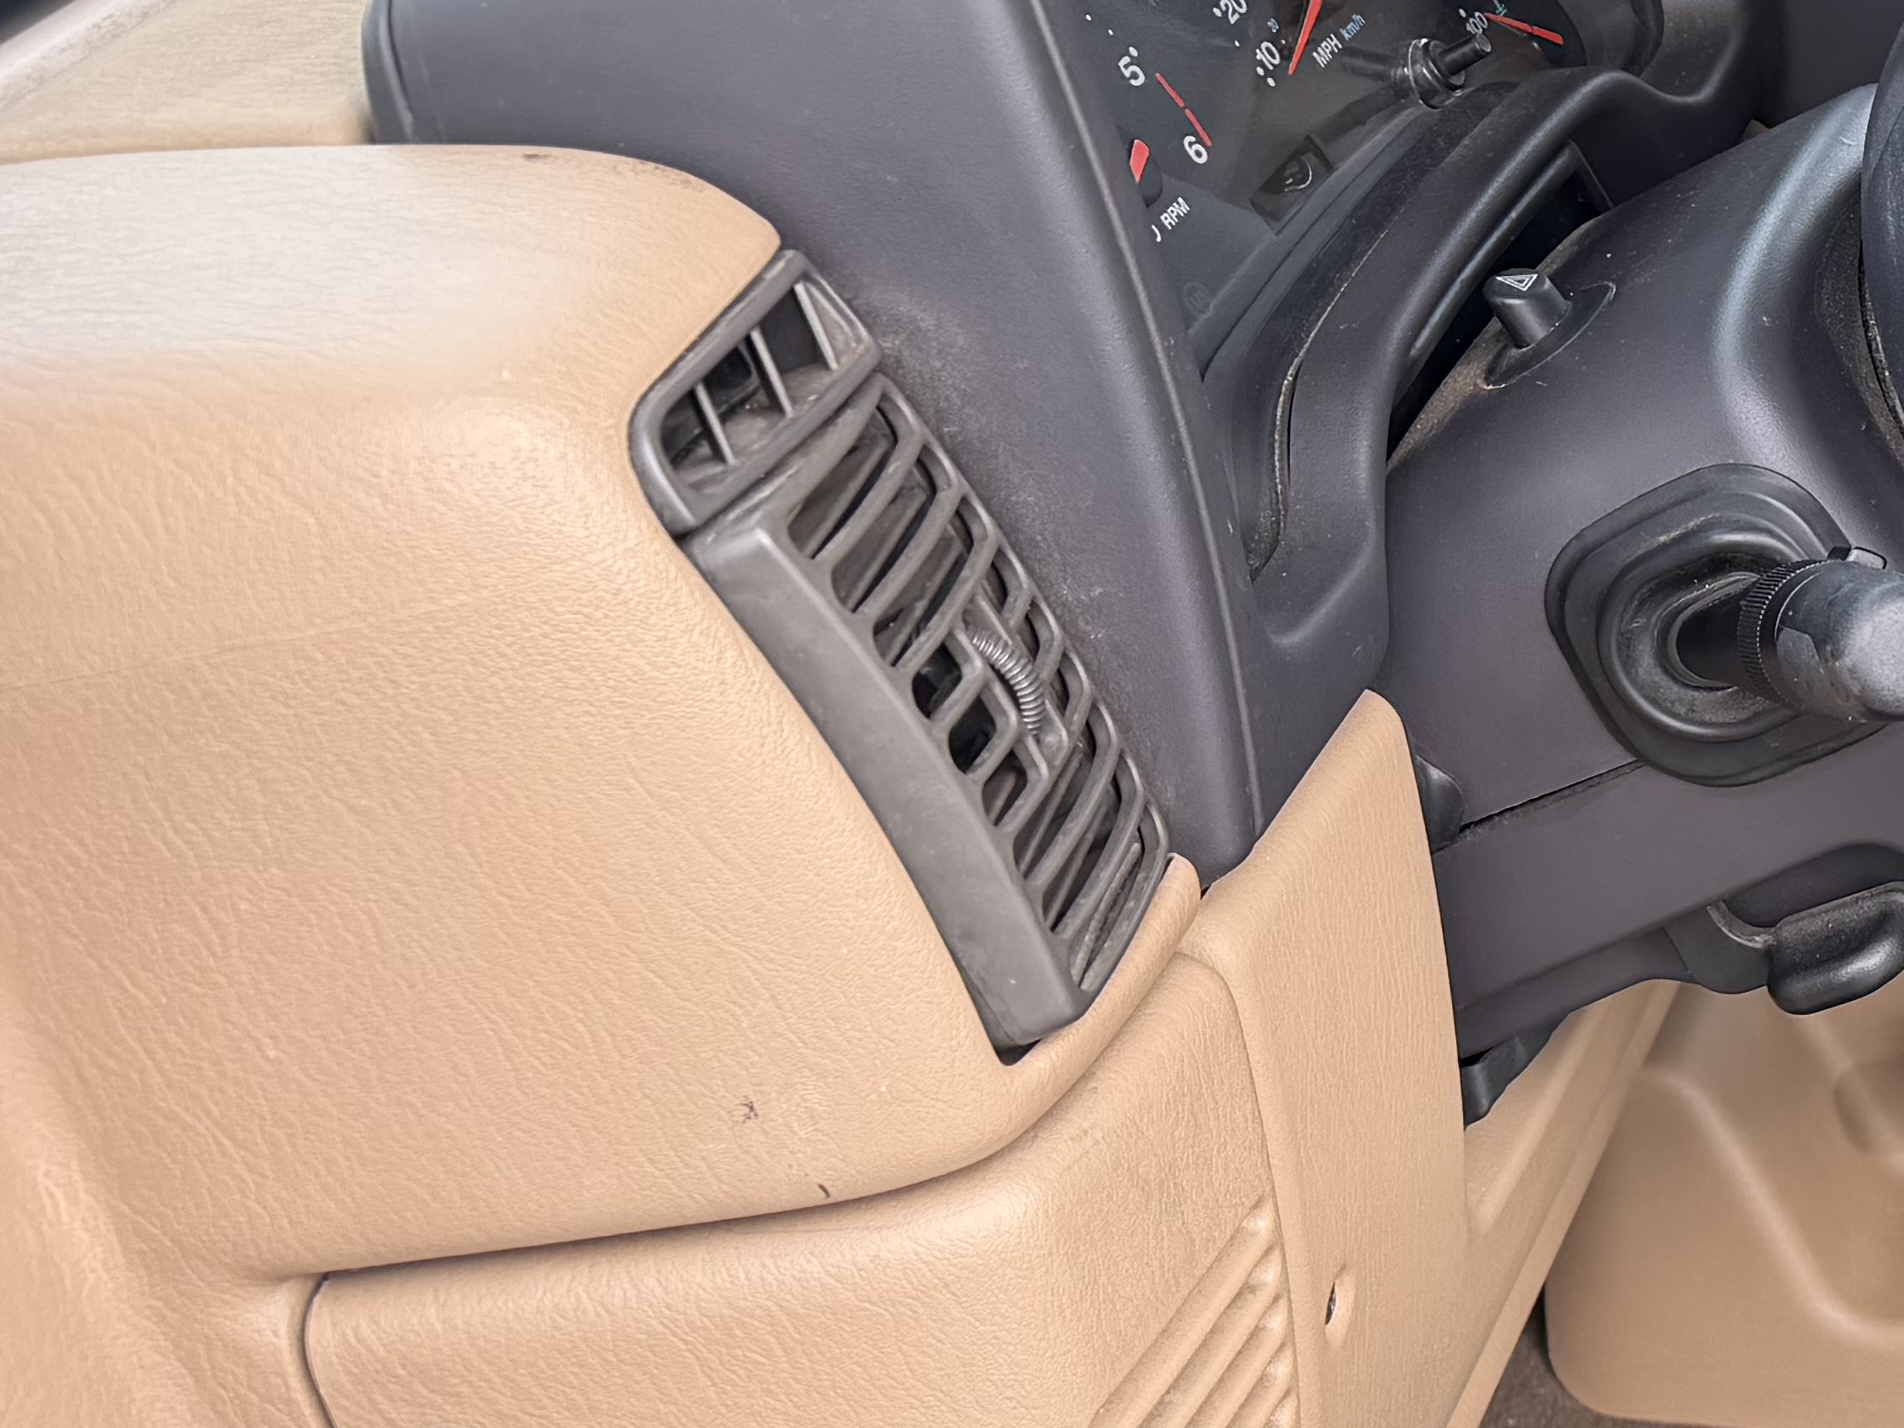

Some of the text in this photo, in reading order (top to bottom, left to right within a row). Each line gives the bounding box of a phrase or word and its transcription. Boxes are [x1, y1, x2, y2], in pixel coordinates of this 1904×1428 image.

[1465, 12, 1487, 36] 100
[1312, 13, 1366, 68] MPH km/h
[1256, 41, 1280, 71] 10
[1118, 56, 1145, 87] 5
[1183, 135, 1208, 164] 6
[1160, 196, 1191, 230] RPM
